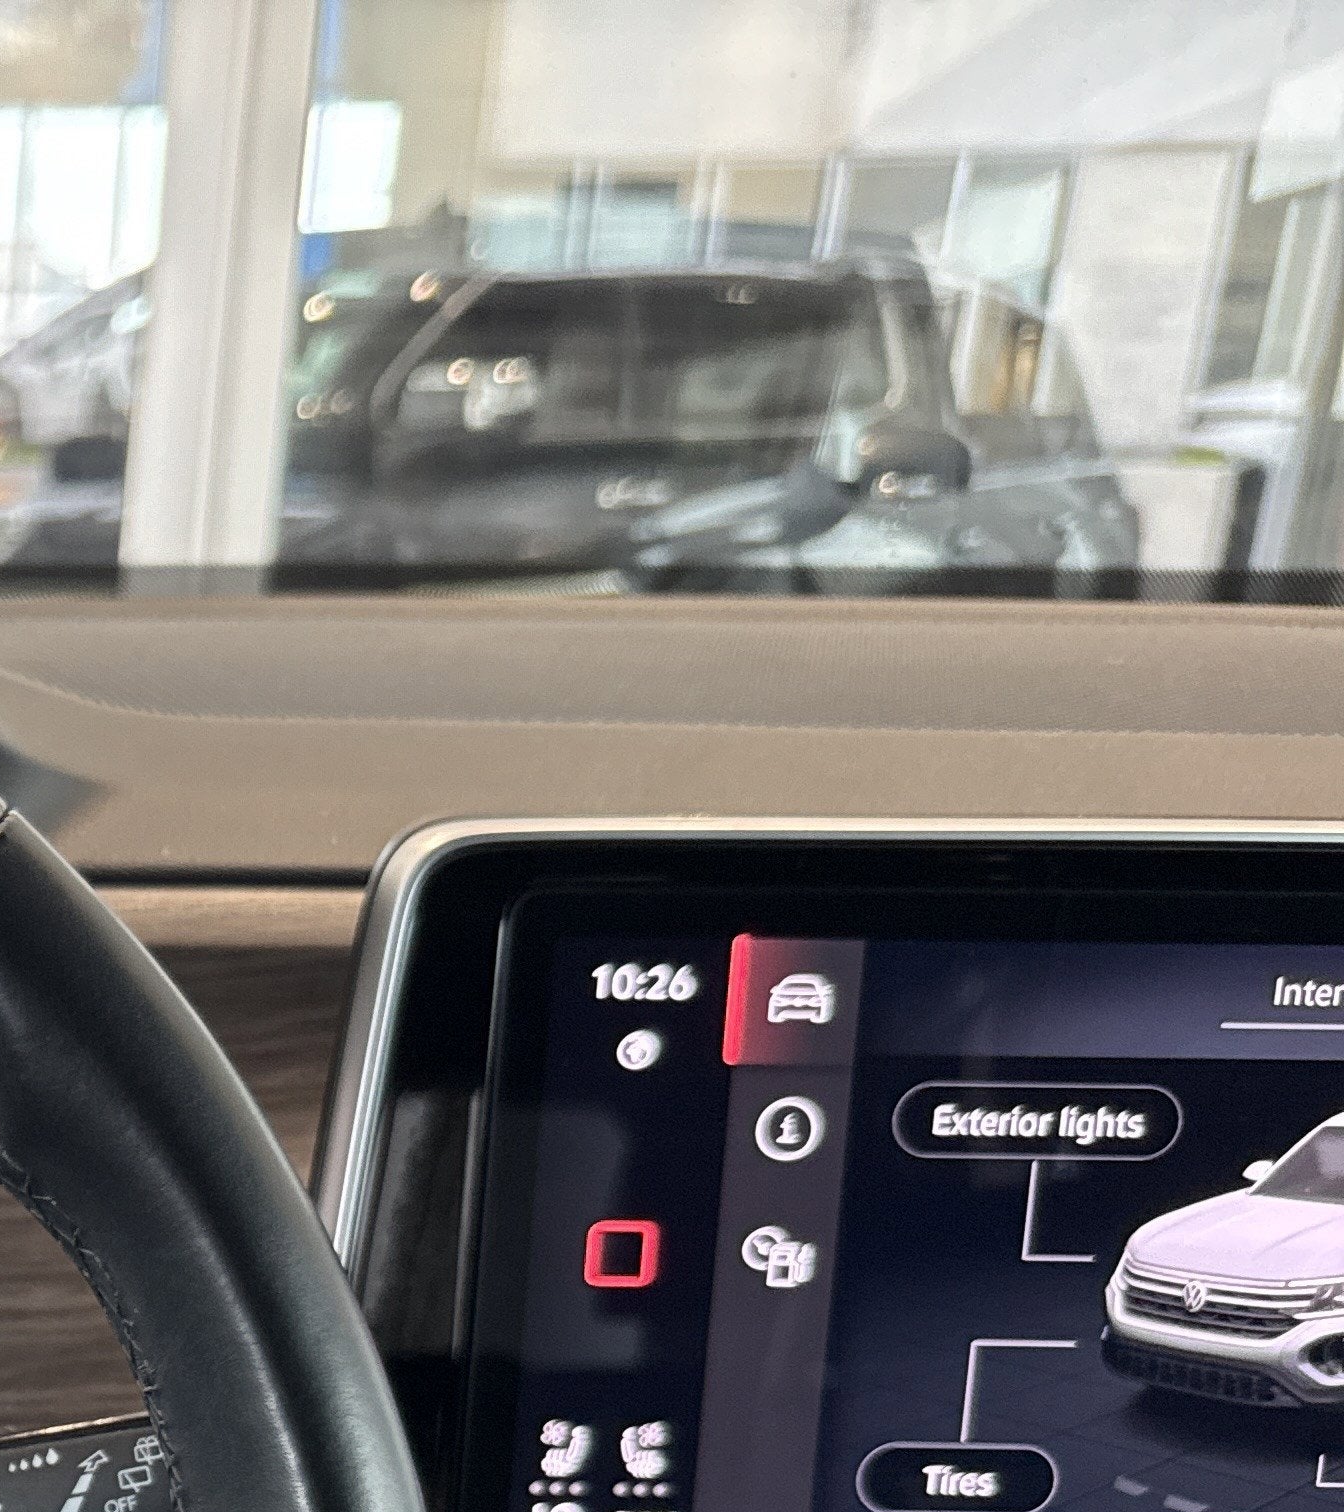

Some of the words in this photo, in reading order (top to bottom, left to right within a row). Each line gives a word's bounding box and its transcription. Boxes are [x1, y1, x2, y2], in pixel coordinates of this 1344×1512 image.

[591, 962, 700, 1002] 10:26
[931, 1105, 1054, 1139] Exterior
[1058, 1104, 1148, 1143] lights
[922, 1465, 1000, 1499] Tires
